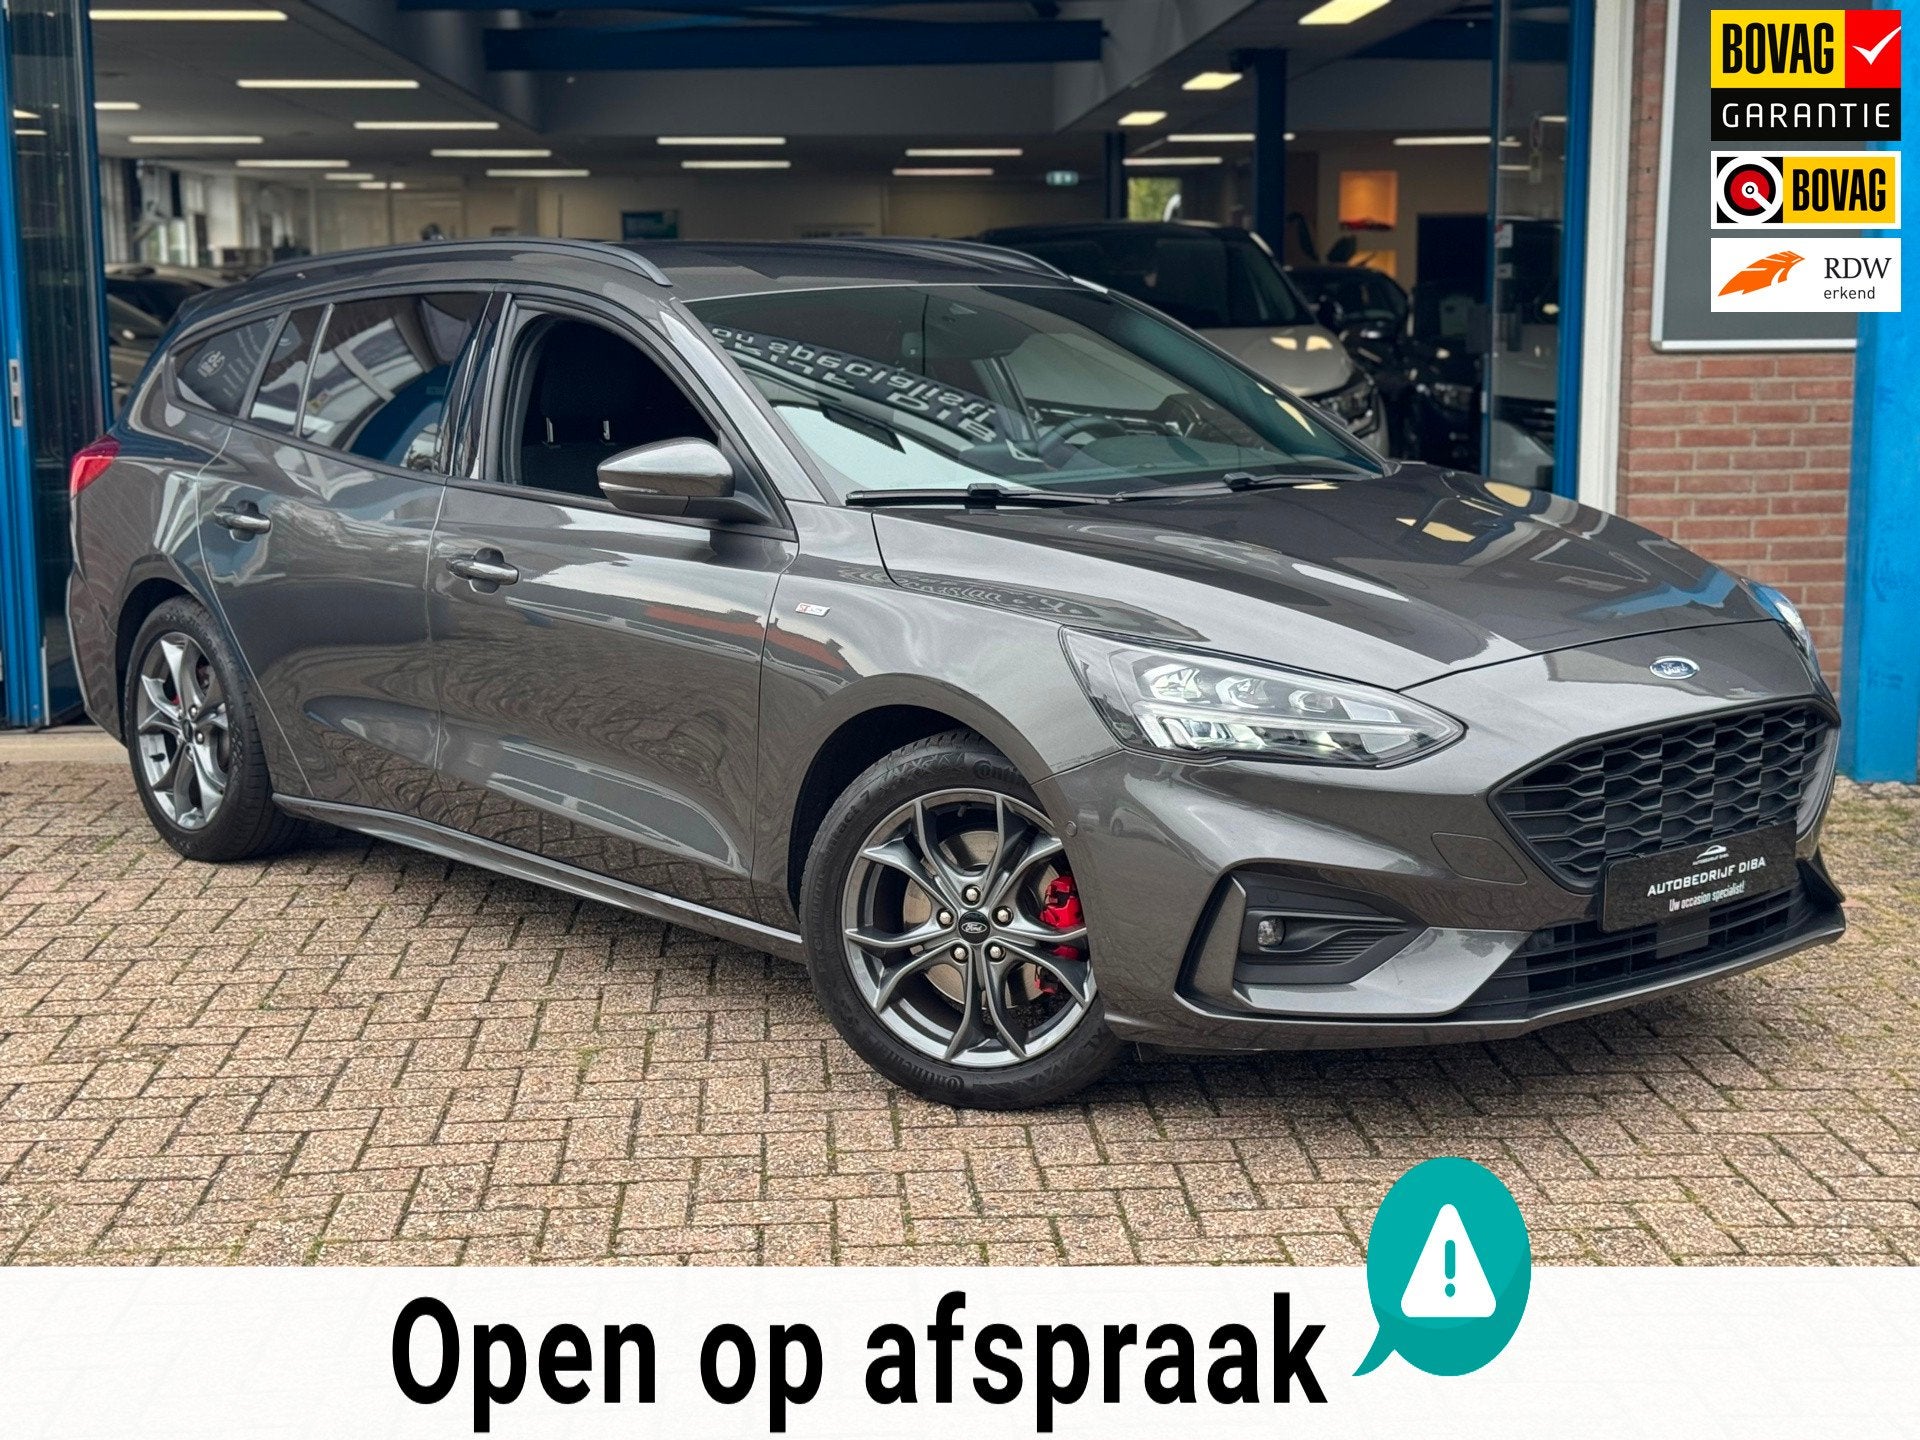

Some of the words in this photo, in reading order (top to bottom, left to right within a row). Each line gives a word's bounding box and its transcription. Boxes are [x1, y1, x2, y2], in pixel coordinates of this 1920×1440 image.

[1647, 864, 1736, 897] AUTOBEDRIJF
[1738, 856, 1767, 874] DIBA
[1681, 891, 1712, 909] occasion
